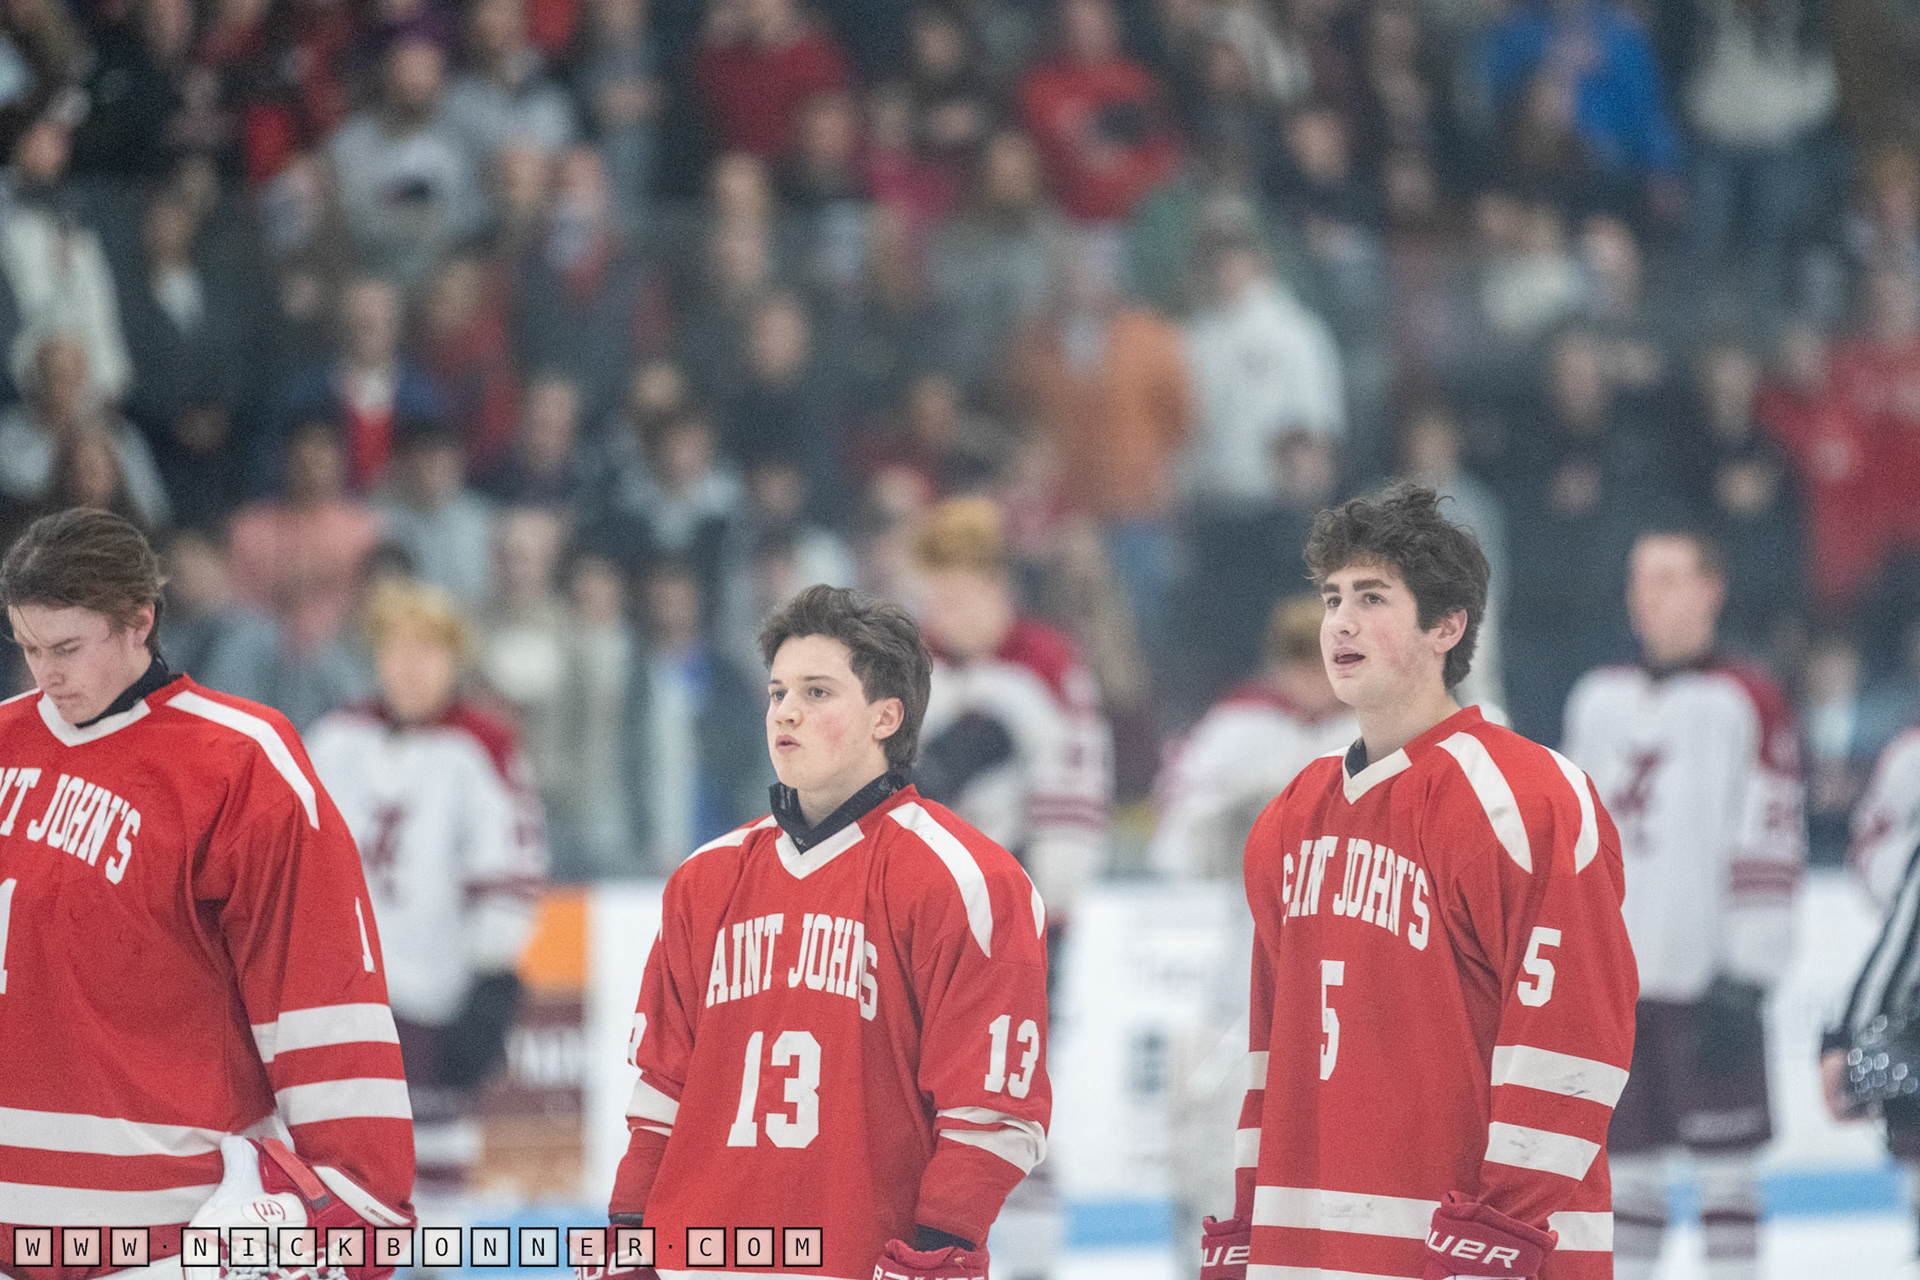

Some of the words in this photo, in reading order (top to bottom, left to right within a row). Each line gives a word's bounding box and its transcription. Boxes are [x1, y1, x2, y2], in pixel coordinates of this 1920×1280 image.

[26, 773, 141, 885] JOHN'S
[355, 896, 376, 973] 1
[1332, 838, 1430, 951] JOHN'S
[1516, 926, 1562, 1007] 5
[984, 1014, 1040, 1099] 13
[1319, 960, 1345, 1081] 5
[726, 1031, 822, 1149] 13
[1425, 1227, 1520, 1268] UER
